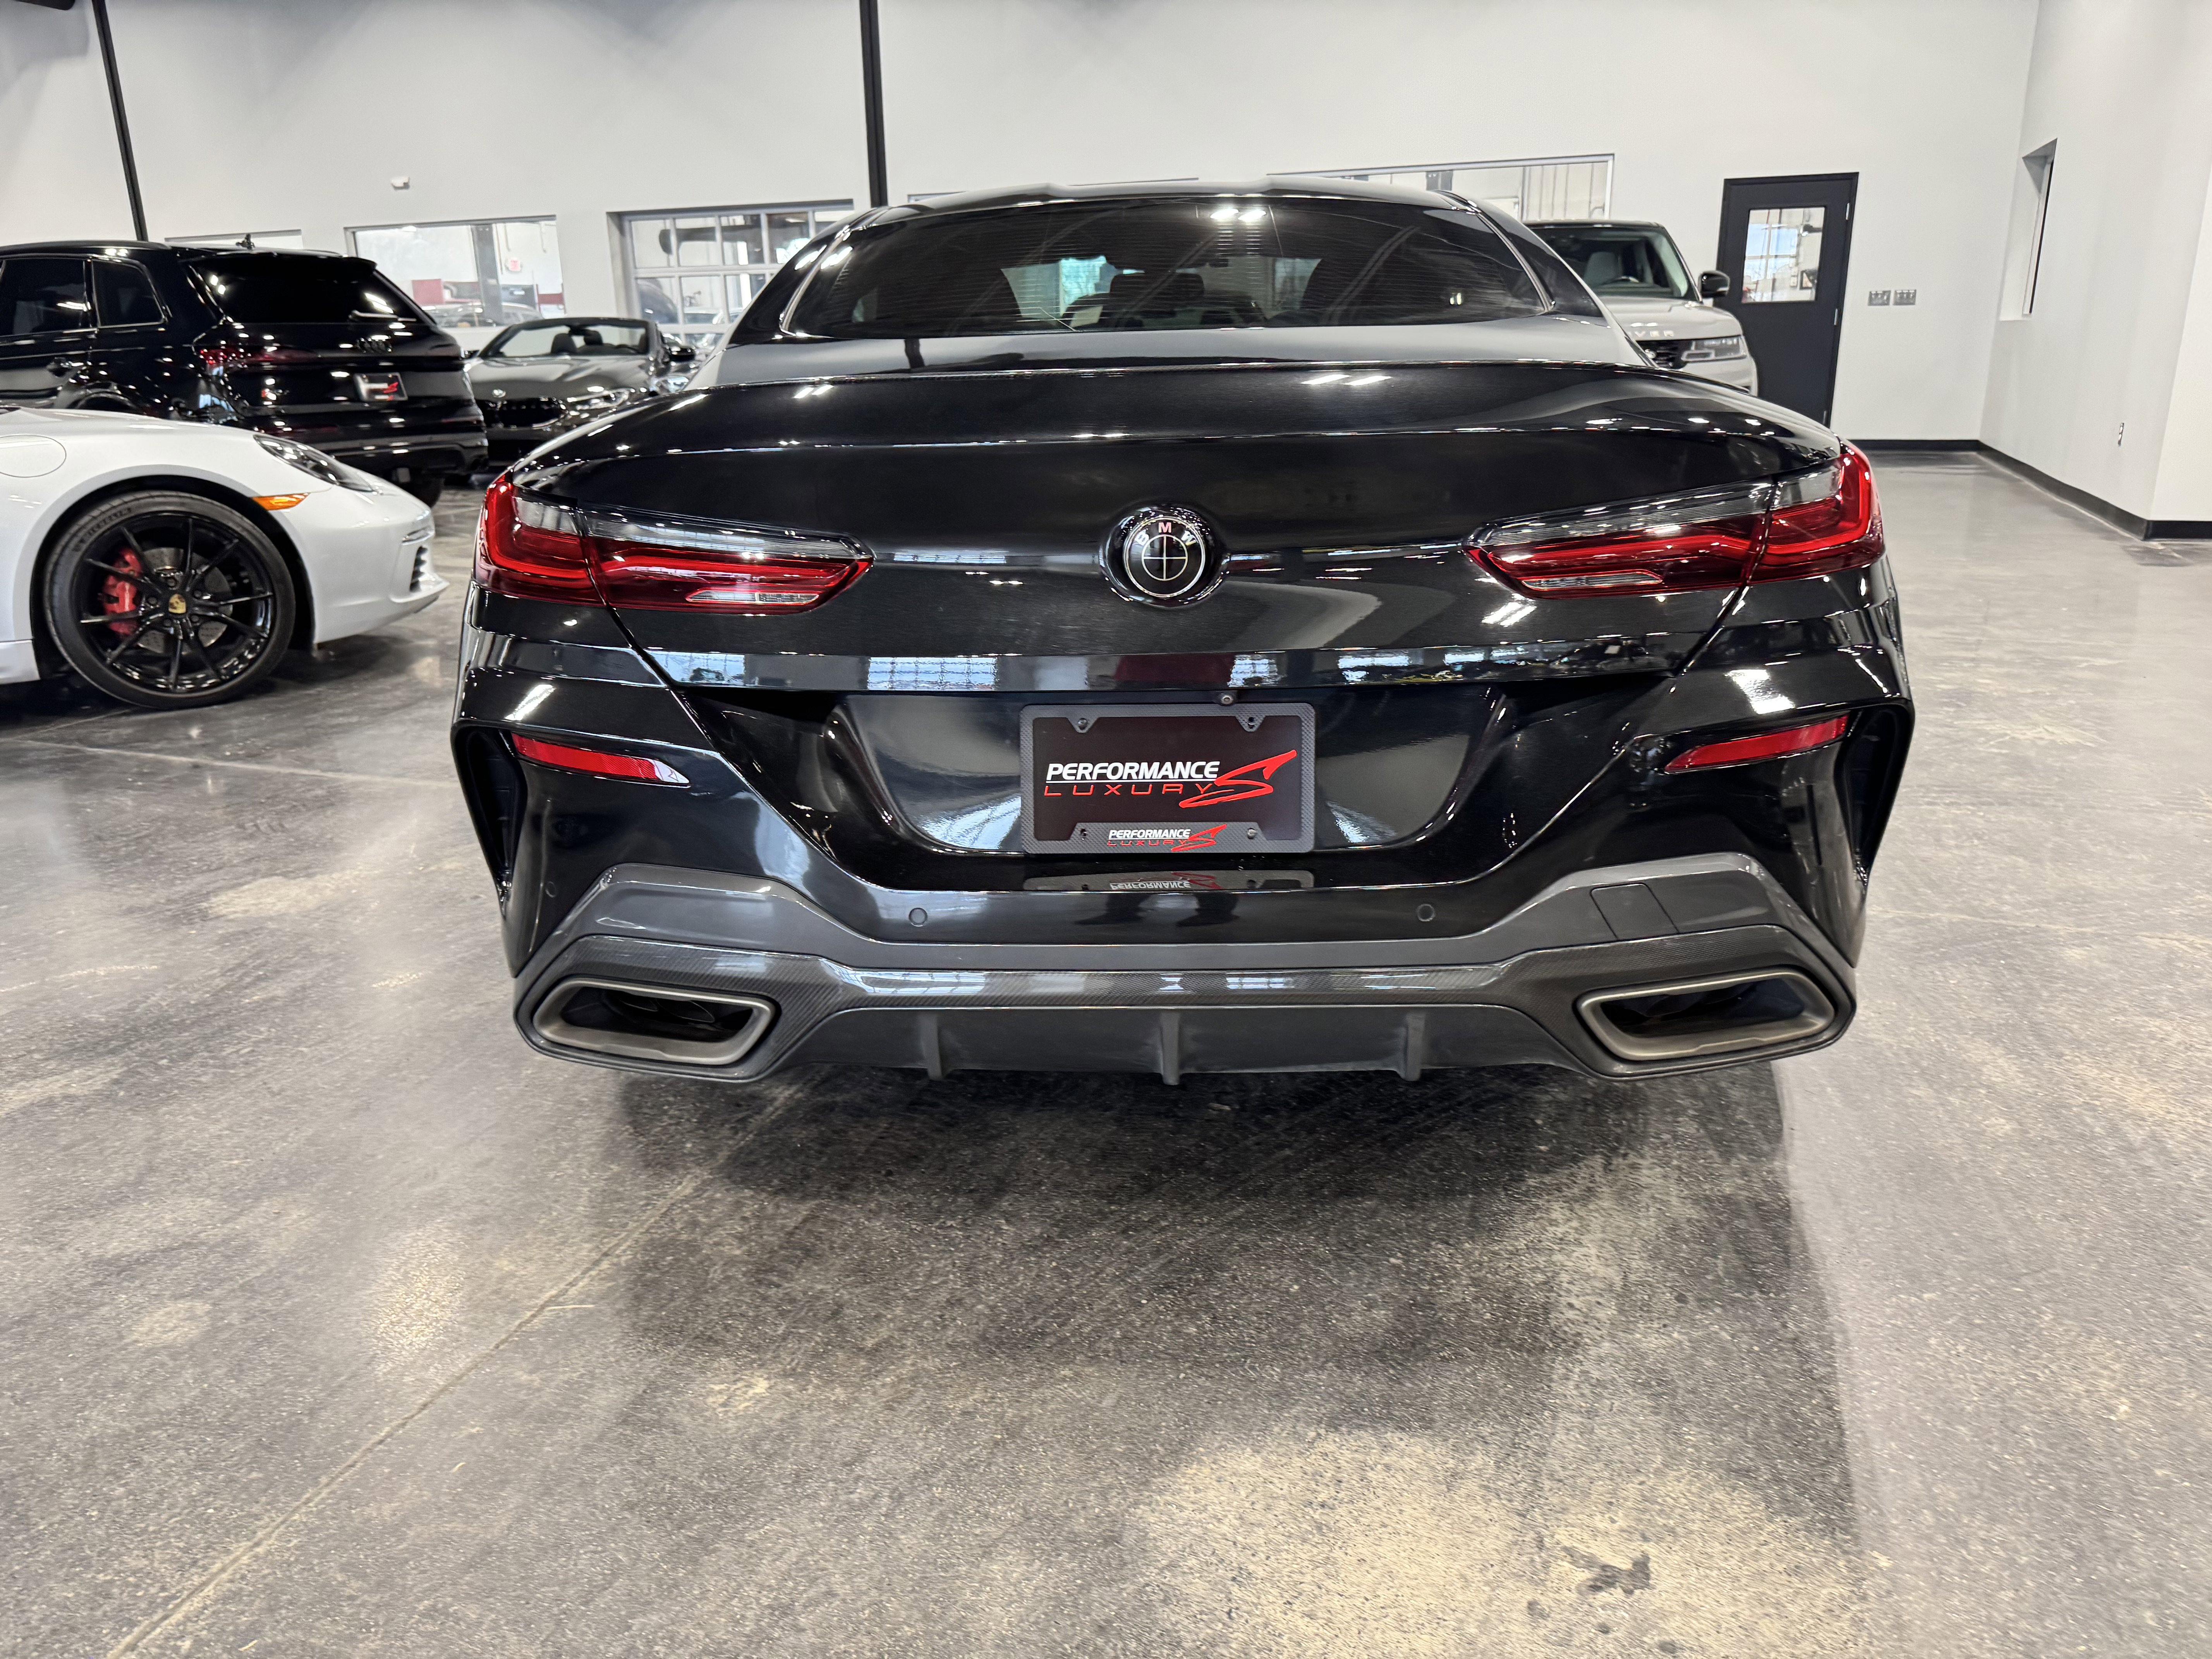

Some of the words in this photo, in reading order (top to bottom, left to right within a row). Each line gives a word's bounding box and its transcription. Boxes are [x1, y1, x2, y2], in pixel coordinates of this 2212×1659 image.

[1158, 522, 1171, 533] M
[1046, 761, 1220, 780] PERFORMANCE
[1044, 783, 1213, 796] LUXURY
[1108, 829, 1191, 838] PERFORMANCE
